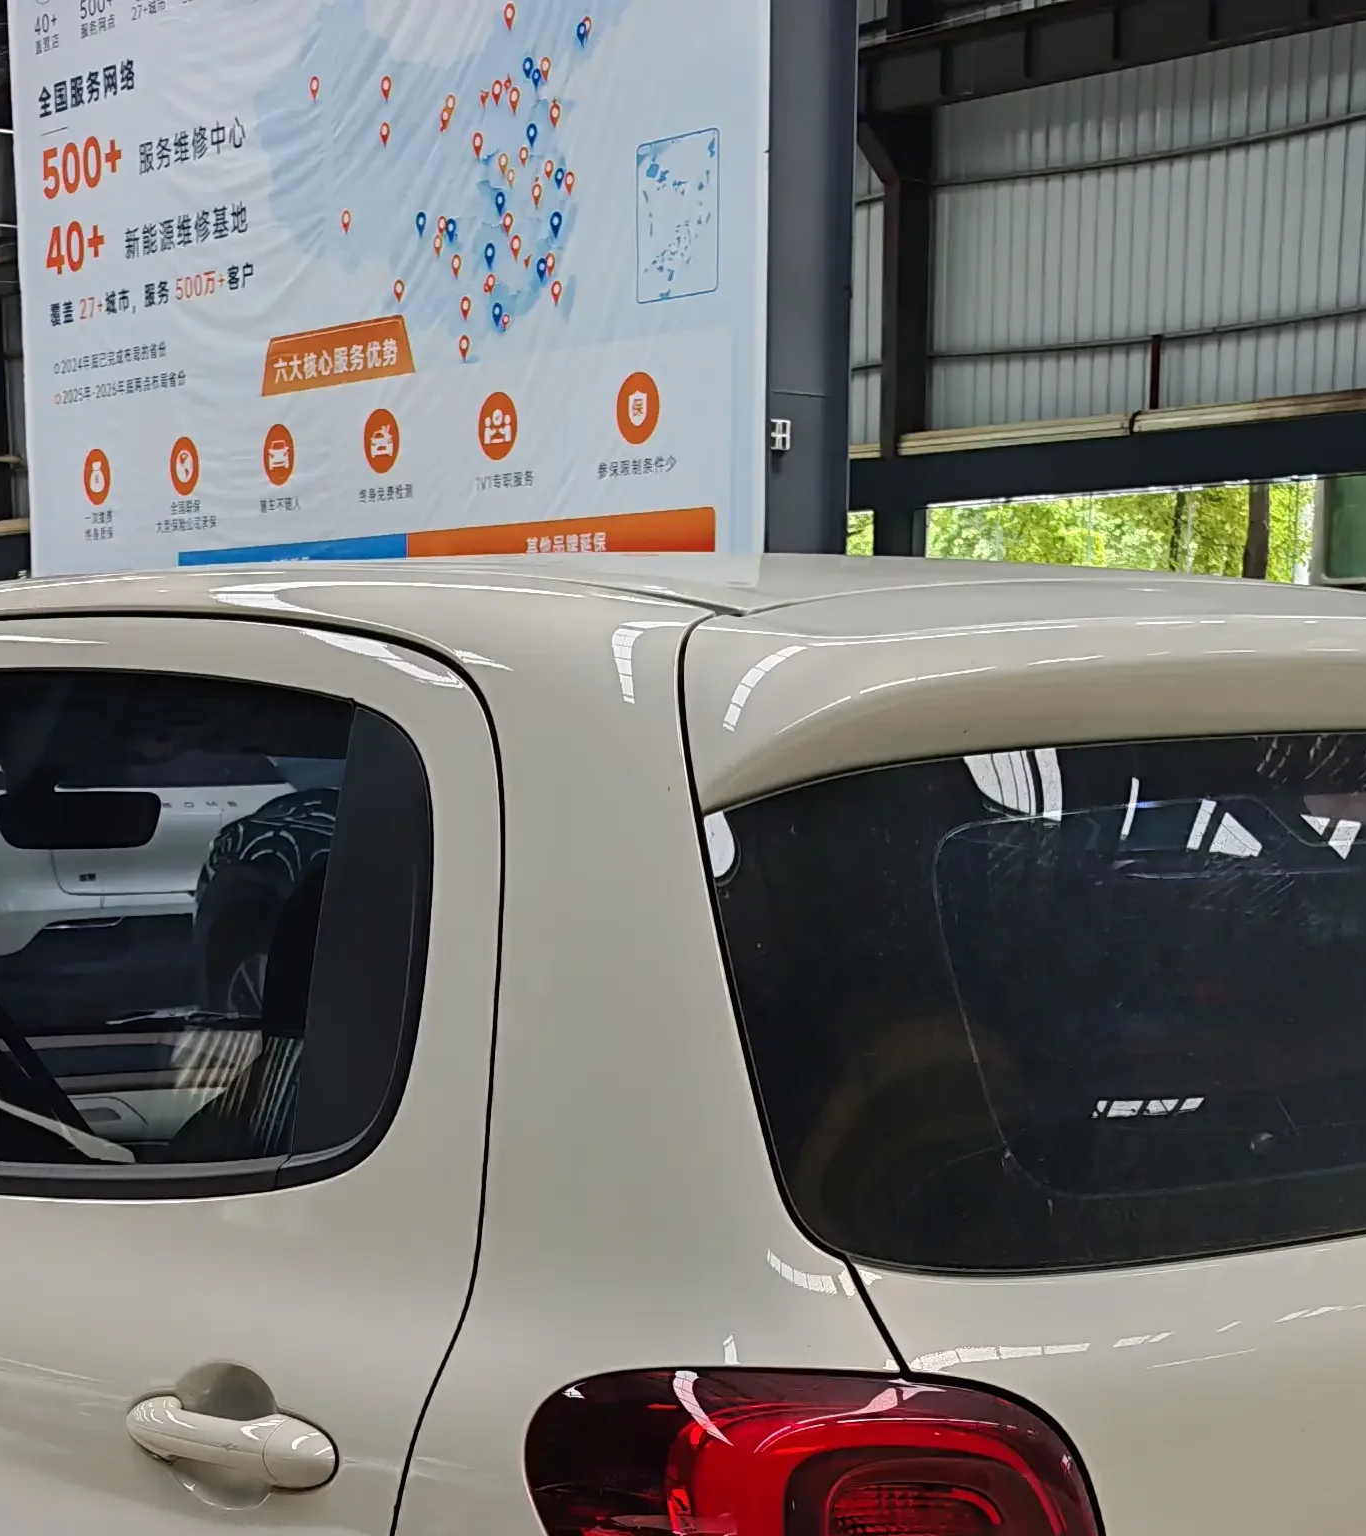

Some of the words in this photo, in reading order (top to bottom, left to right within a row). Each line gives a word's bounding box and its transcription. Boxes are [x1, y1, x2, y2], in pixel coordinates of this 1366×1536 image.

[34, 13, 58, 35] 40+
[38, 58, 135, 118] 全国服务网络
[42, 135, 123, 200] 500+
[139, 117, 246, 175] 服务维修中心
[46, 220, 105, 275] 40+
[124, 201, 248, 260] 新能源维修基地
[273, 337, 398, 384] 六大核心服务优势
[597, 455, 677, 480] 参保限制条件少
